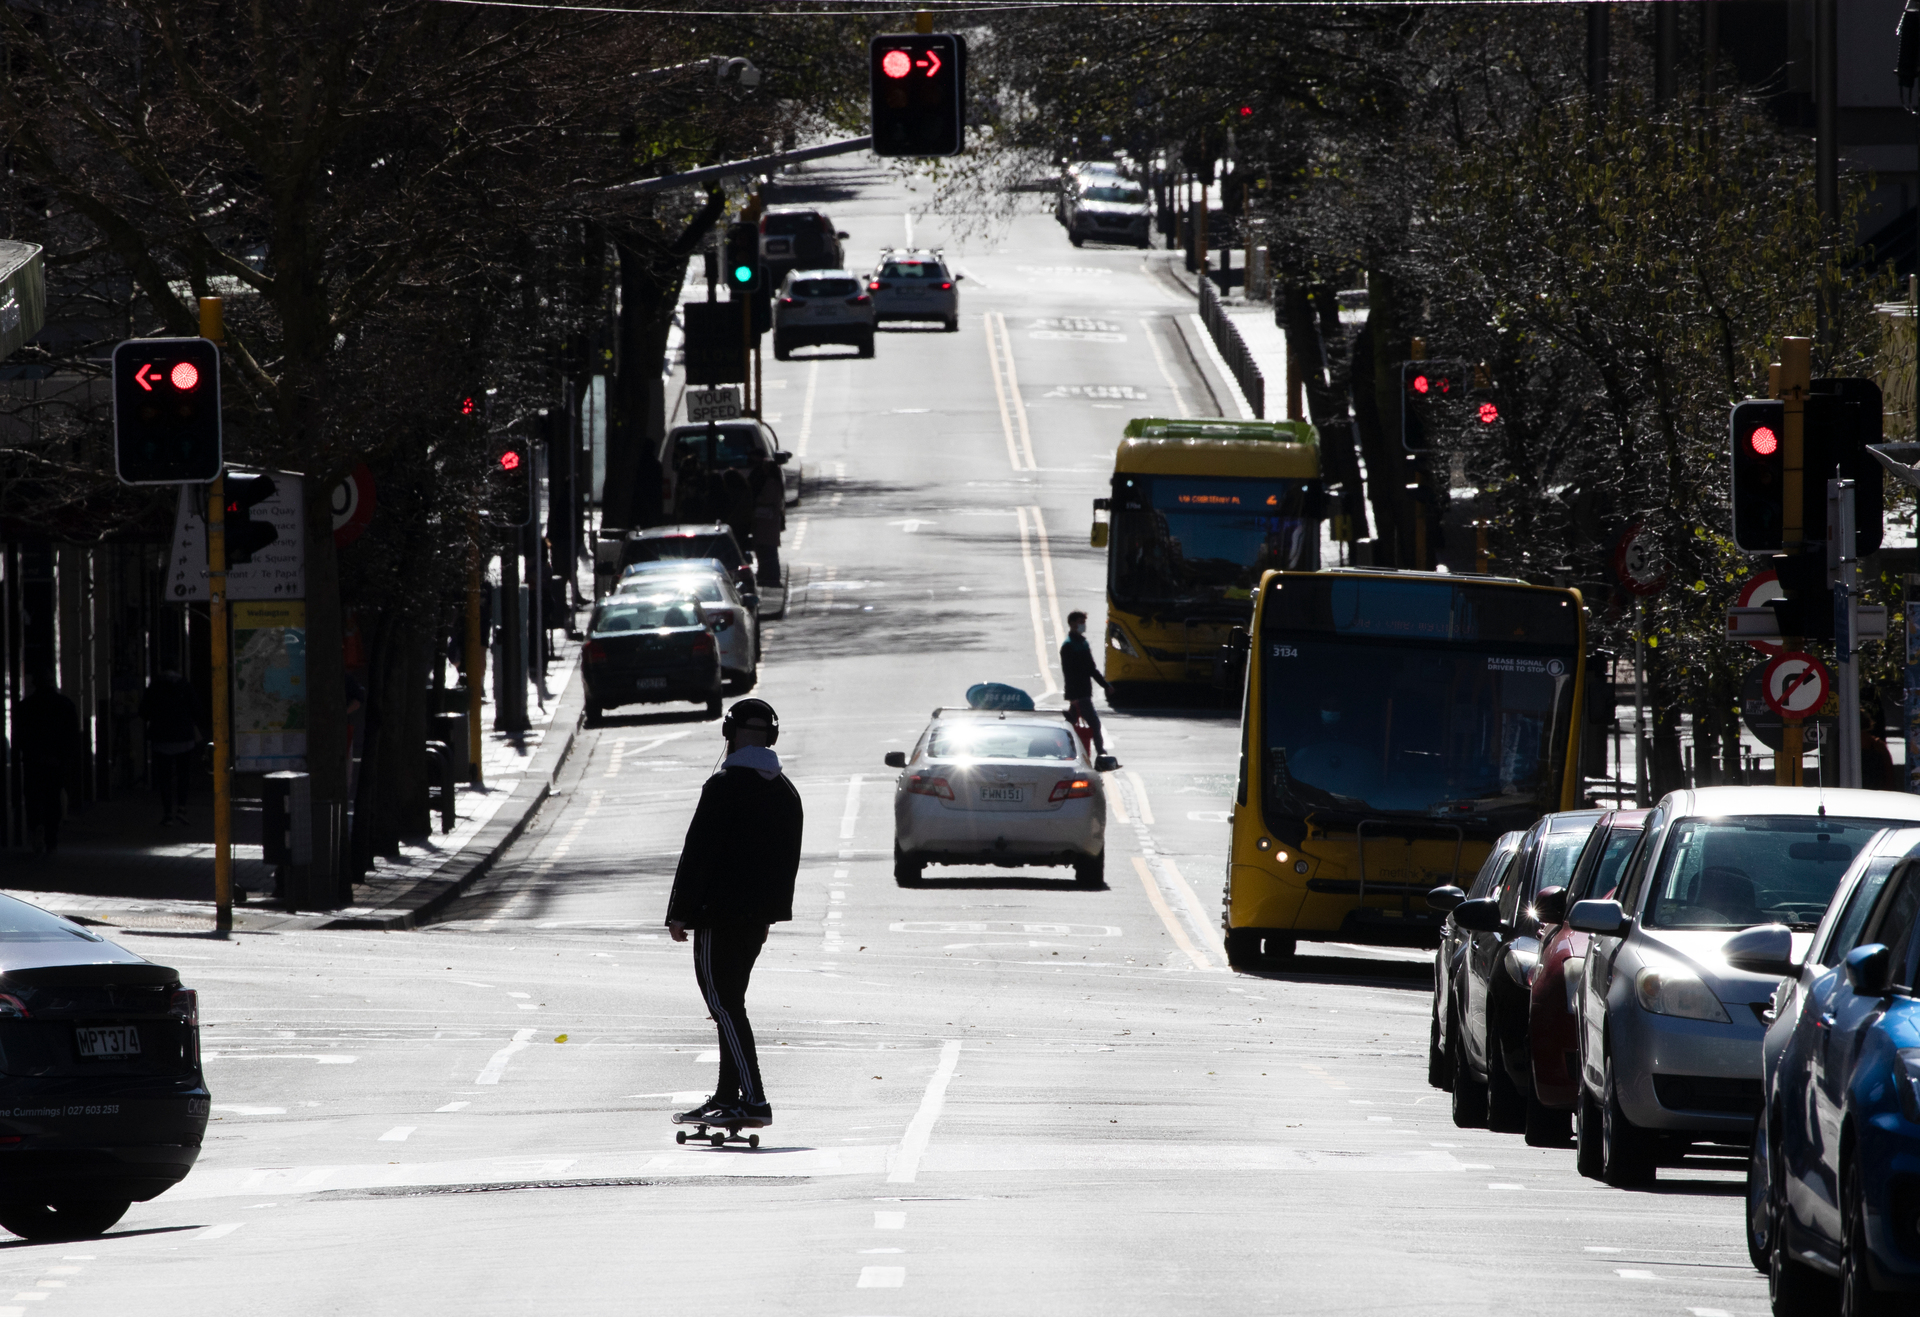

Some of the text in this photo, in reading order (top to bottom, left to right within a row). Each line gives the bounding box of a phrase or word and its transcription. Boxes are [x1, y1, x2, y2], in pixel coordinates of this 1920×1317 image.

[695, 391, 732, 405] YOUR
[693, 405, 736, 420] SPEED
[271, 507, 296, 516] Quay
[265, 554, 297, 564] Square
[261, 569, 272, 578] Te
[275, 569, 297, 579] Papa
[1273, 647, 1298, 658] 3134
[1487, 657, 1543, 667] PLEASE SIGNAL
[1487, 664, 1514, 672] DRIVER
[982, 788, 1019, 799] FWN151
[1380, 867, 1419, 878] metlink
[78, 1029, 139, 1053] MPT374
[13, 1107, 61, 1117] Cummings
[67, 1106, 84, 1115] 027
[85, 1105, 101, 1115] 603
[102, 1104, 120, 1114] 2513
